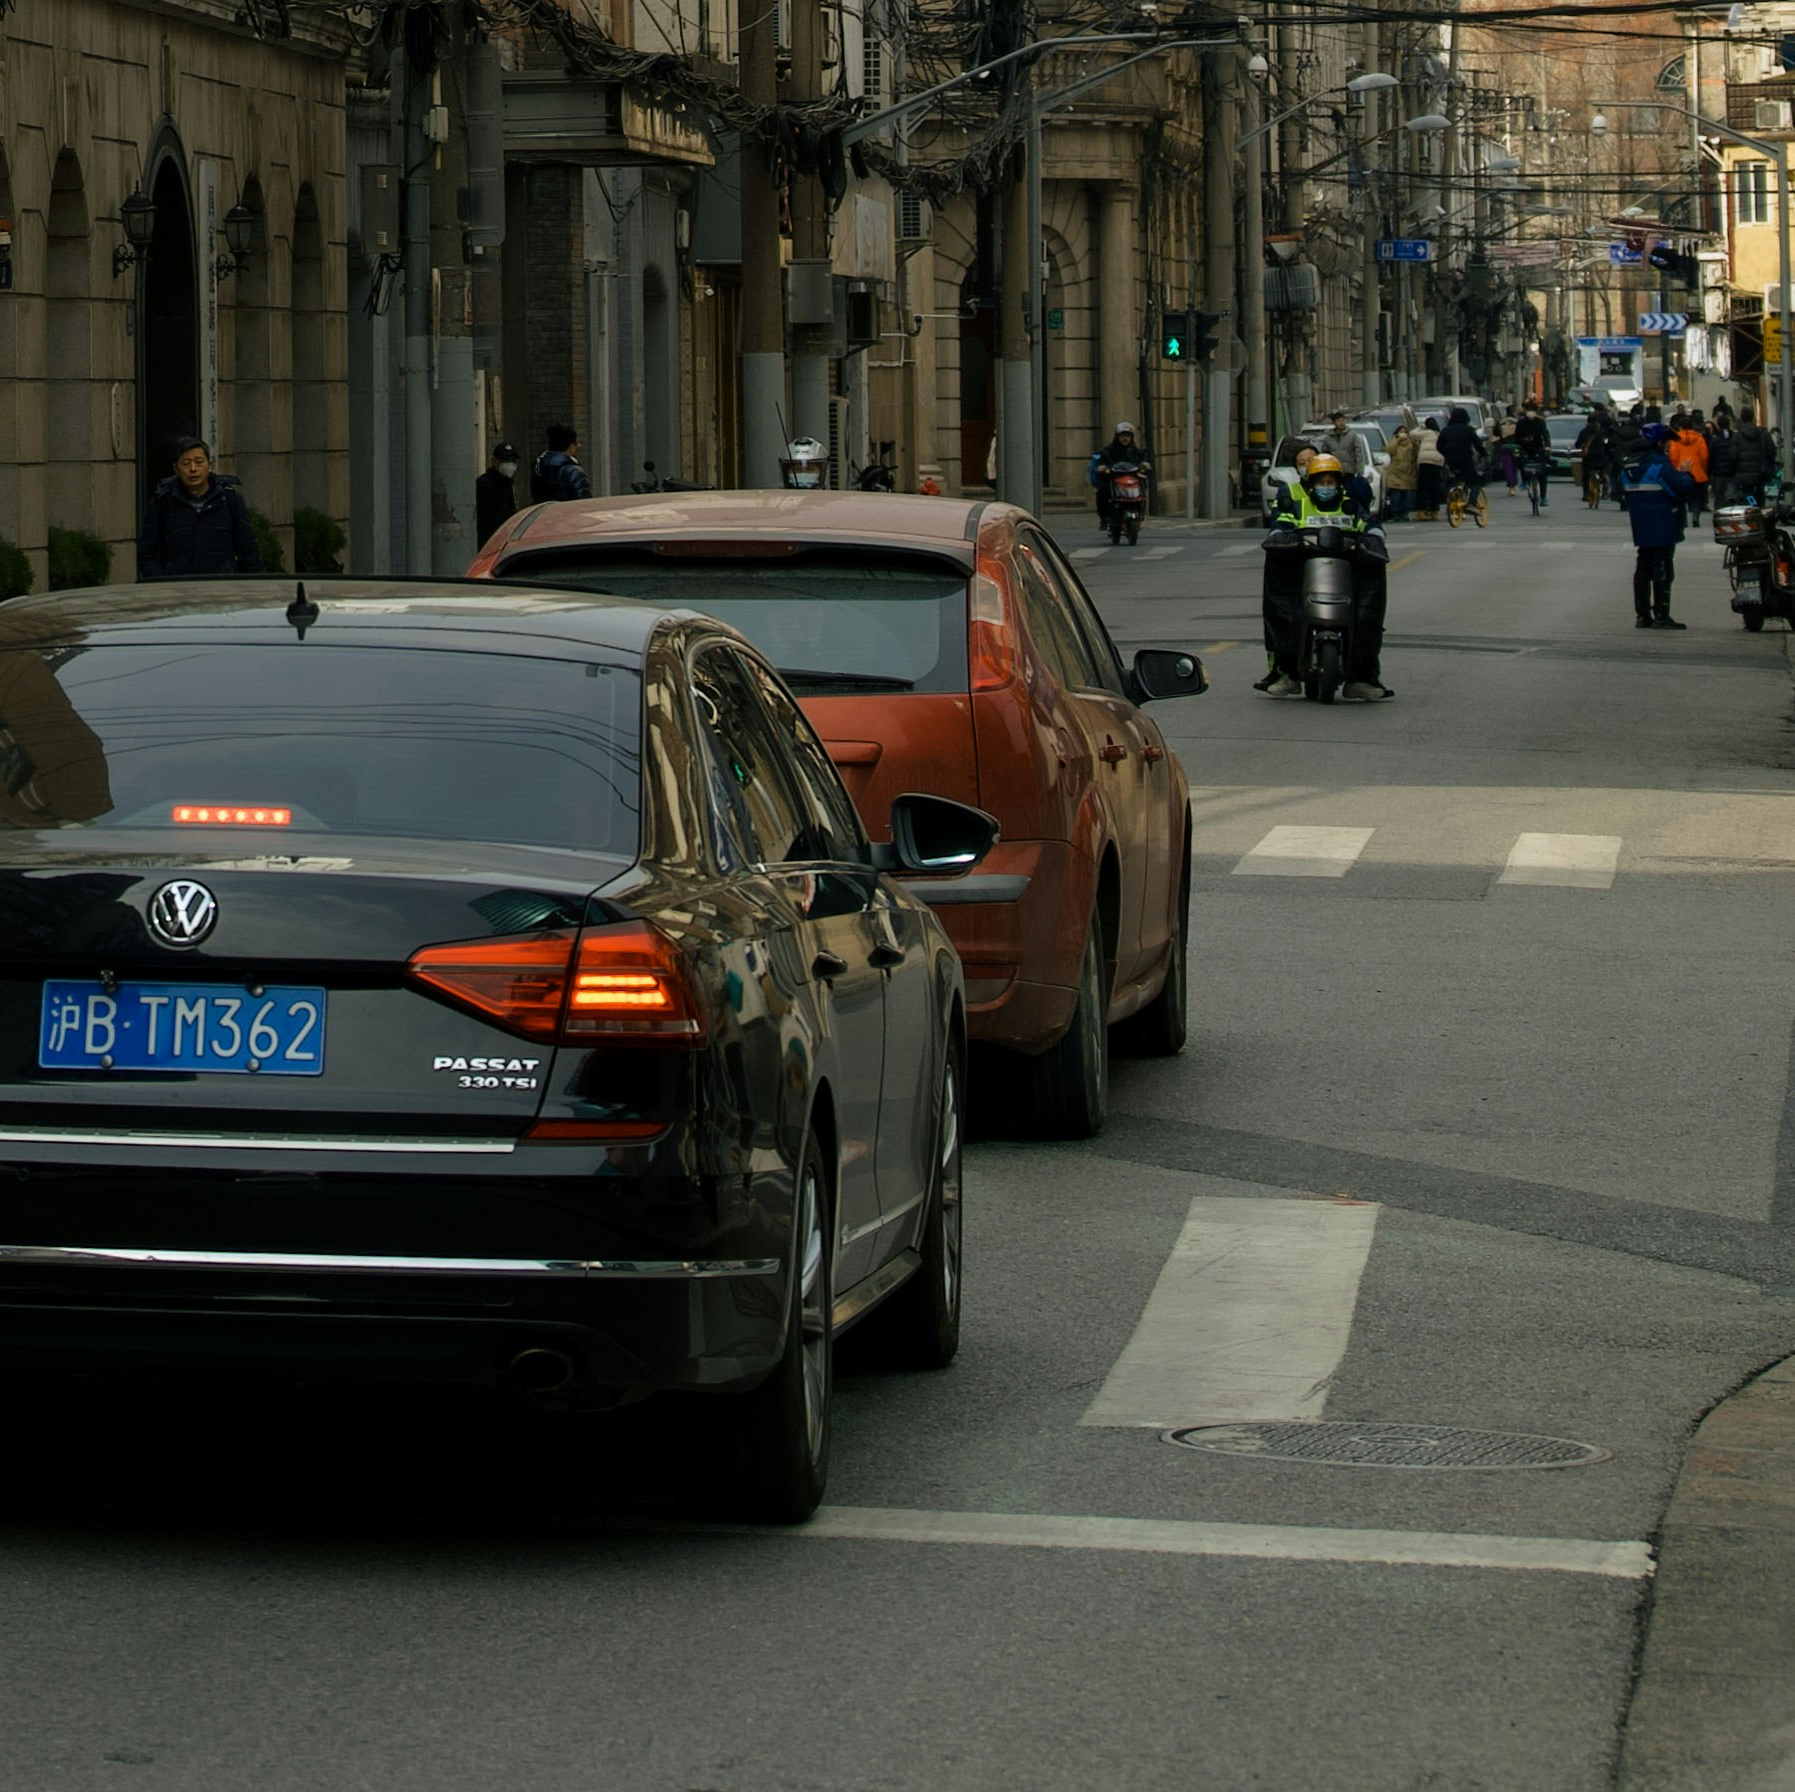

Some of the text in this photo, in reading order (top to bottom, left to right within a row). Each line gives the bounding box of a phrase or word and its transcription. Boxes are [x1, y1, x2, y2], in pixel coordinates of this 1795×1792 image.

[432, 1056, 541, 1073] PASSAT
[458, 1075, 538, 1090] 330 TSI
